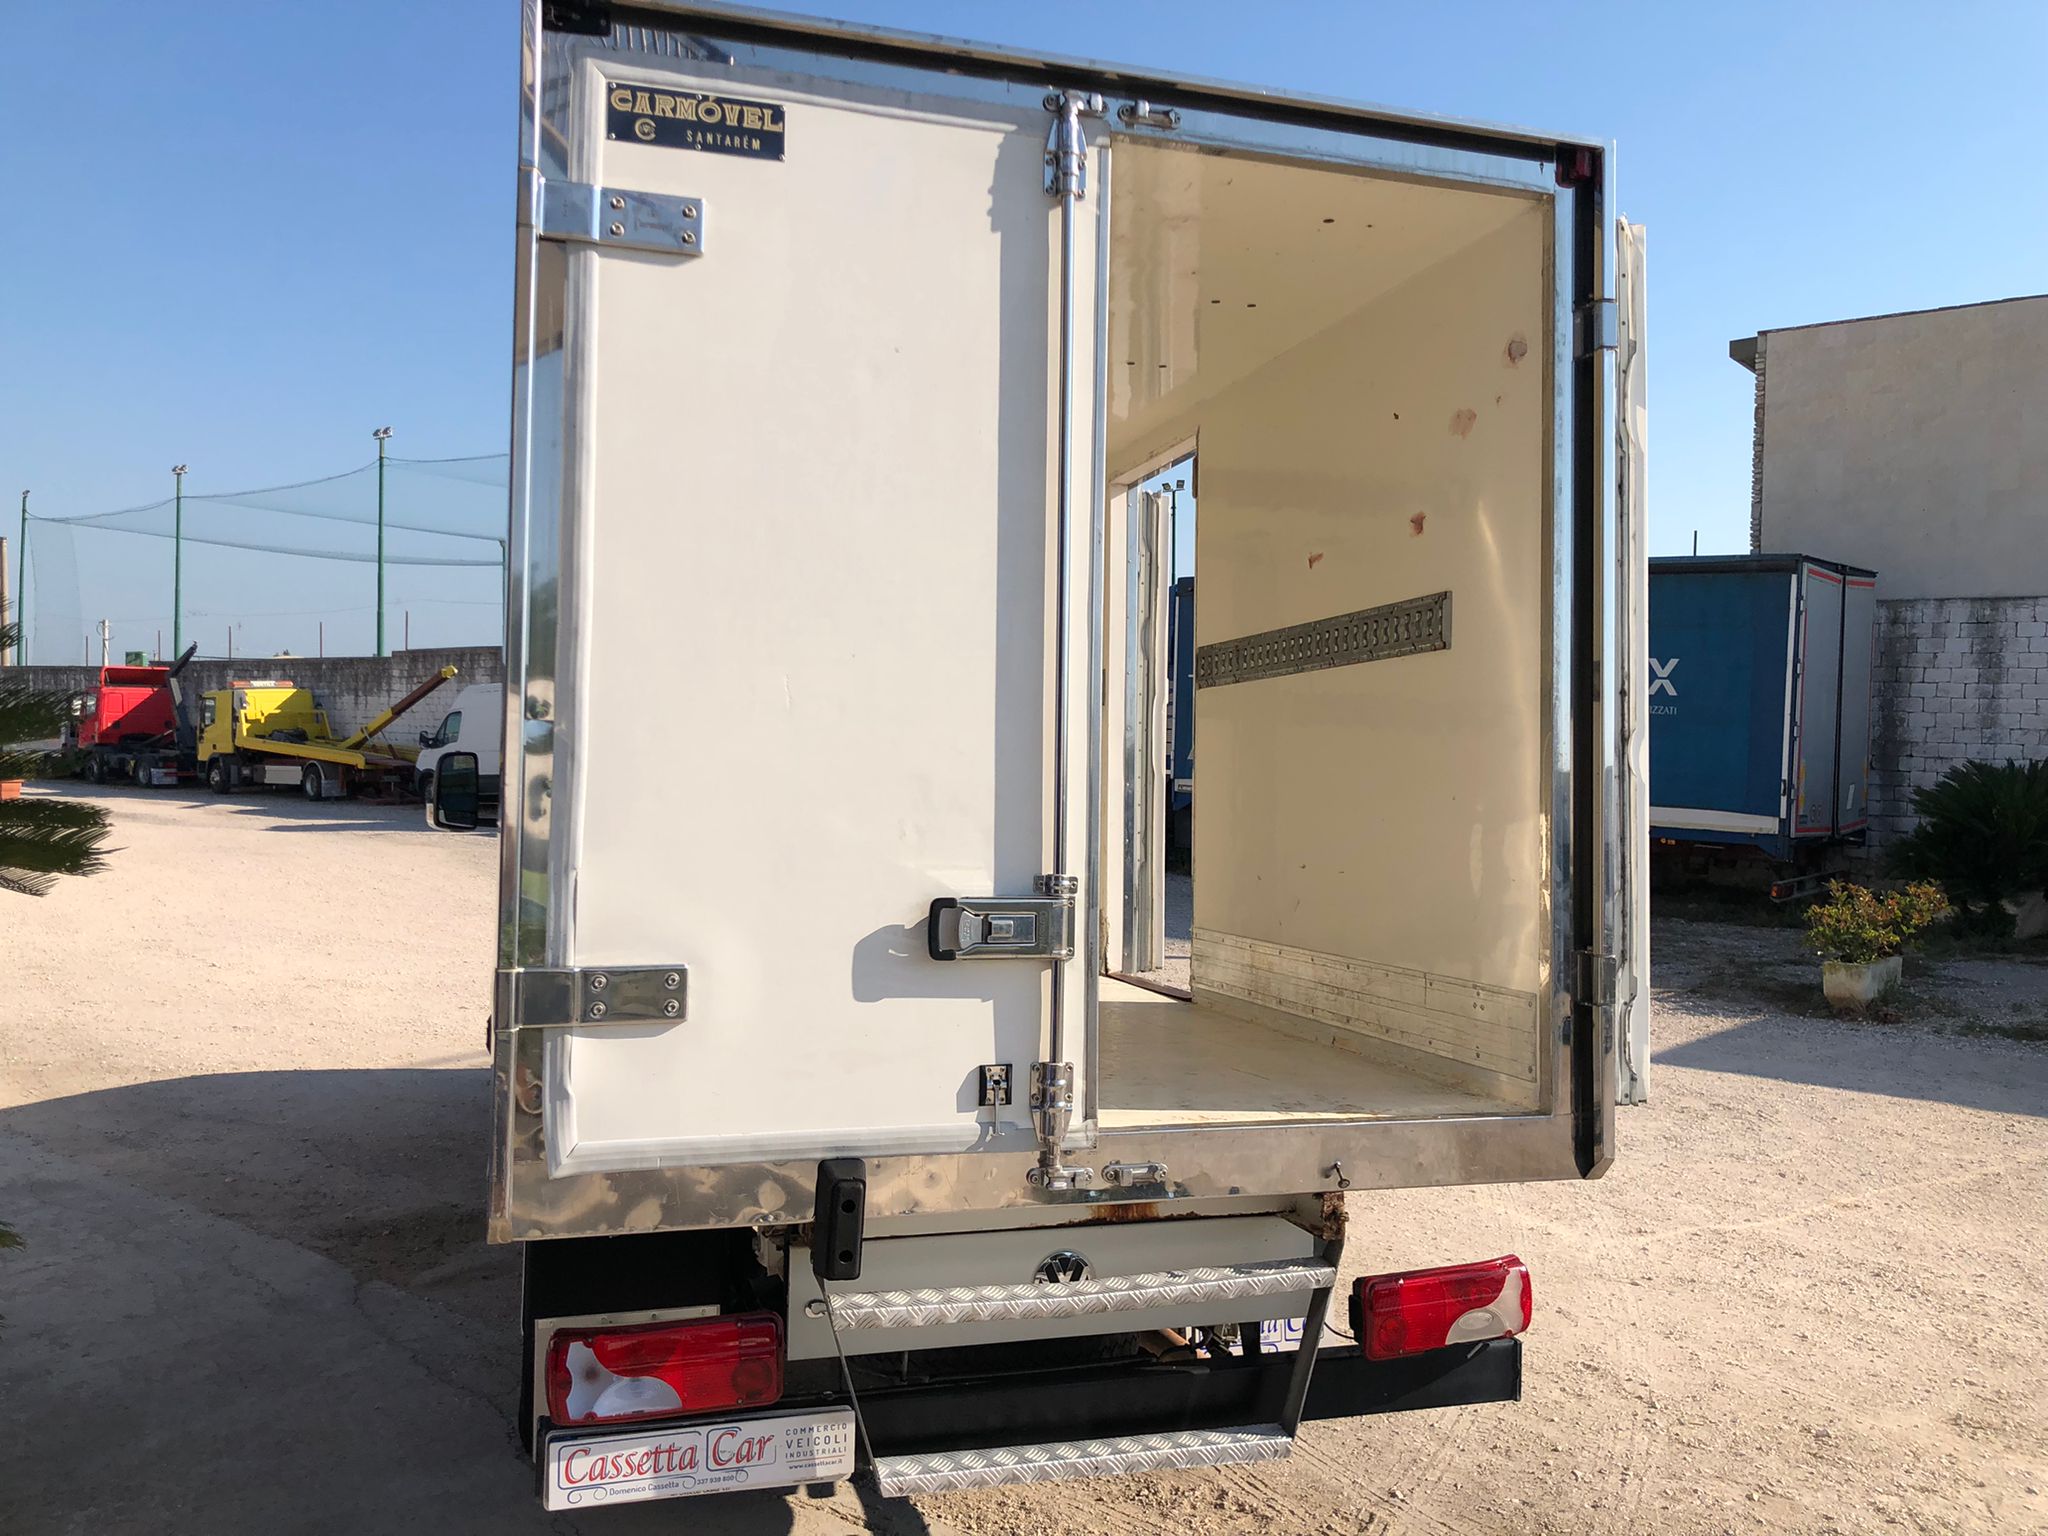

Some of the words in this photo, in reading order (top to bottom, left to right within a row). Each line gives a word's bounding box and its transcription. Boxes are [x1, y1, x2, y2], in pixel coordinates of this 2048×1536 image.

[610, 89, 783, 132] CARMÓVEL
[686, 129, 761, 151] SANTARÉM
[785, 1422, 848, 1436] COMMERCIO
[785, 1434, 848, 1449] VEICOLI
[564, 1441, 700, 1485] Cassetta
[711, 1430, 775, 1467] Car
[785, 1446, 847, 1459] INDUSTRIALI
[609, 1482, 647, 1497] Domenico
[647, 1480, 680, 1492] Cassetta
